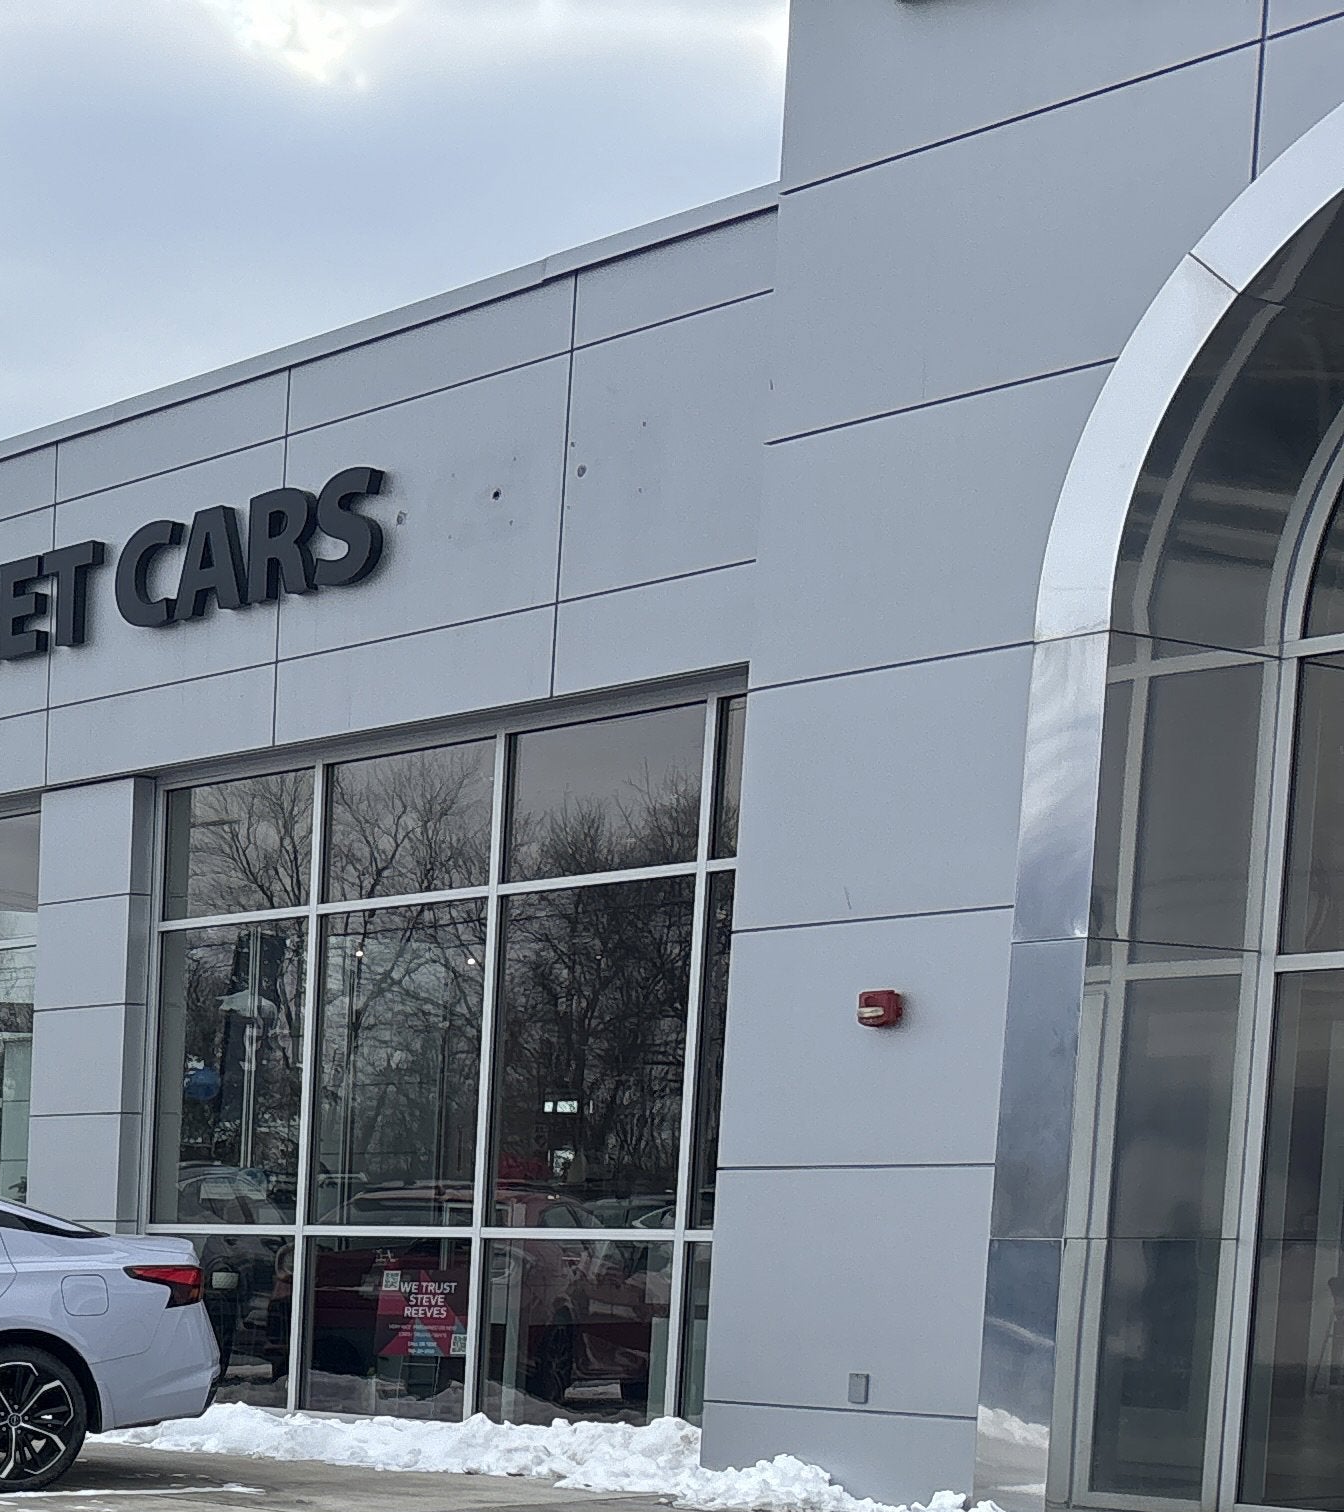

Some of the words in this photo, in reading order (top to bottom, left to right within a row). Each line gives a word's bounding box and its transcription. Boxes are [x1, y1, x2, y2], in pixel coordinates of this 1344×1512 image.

[115, 467, 385, 628] CARS
[400, 1281, 419, 1293] WE
[421, 1281, 457, 1294] TRUST
[409, 1294, 445, 1306] STEVE
[404, 1306, 447, 1318] REEVES
